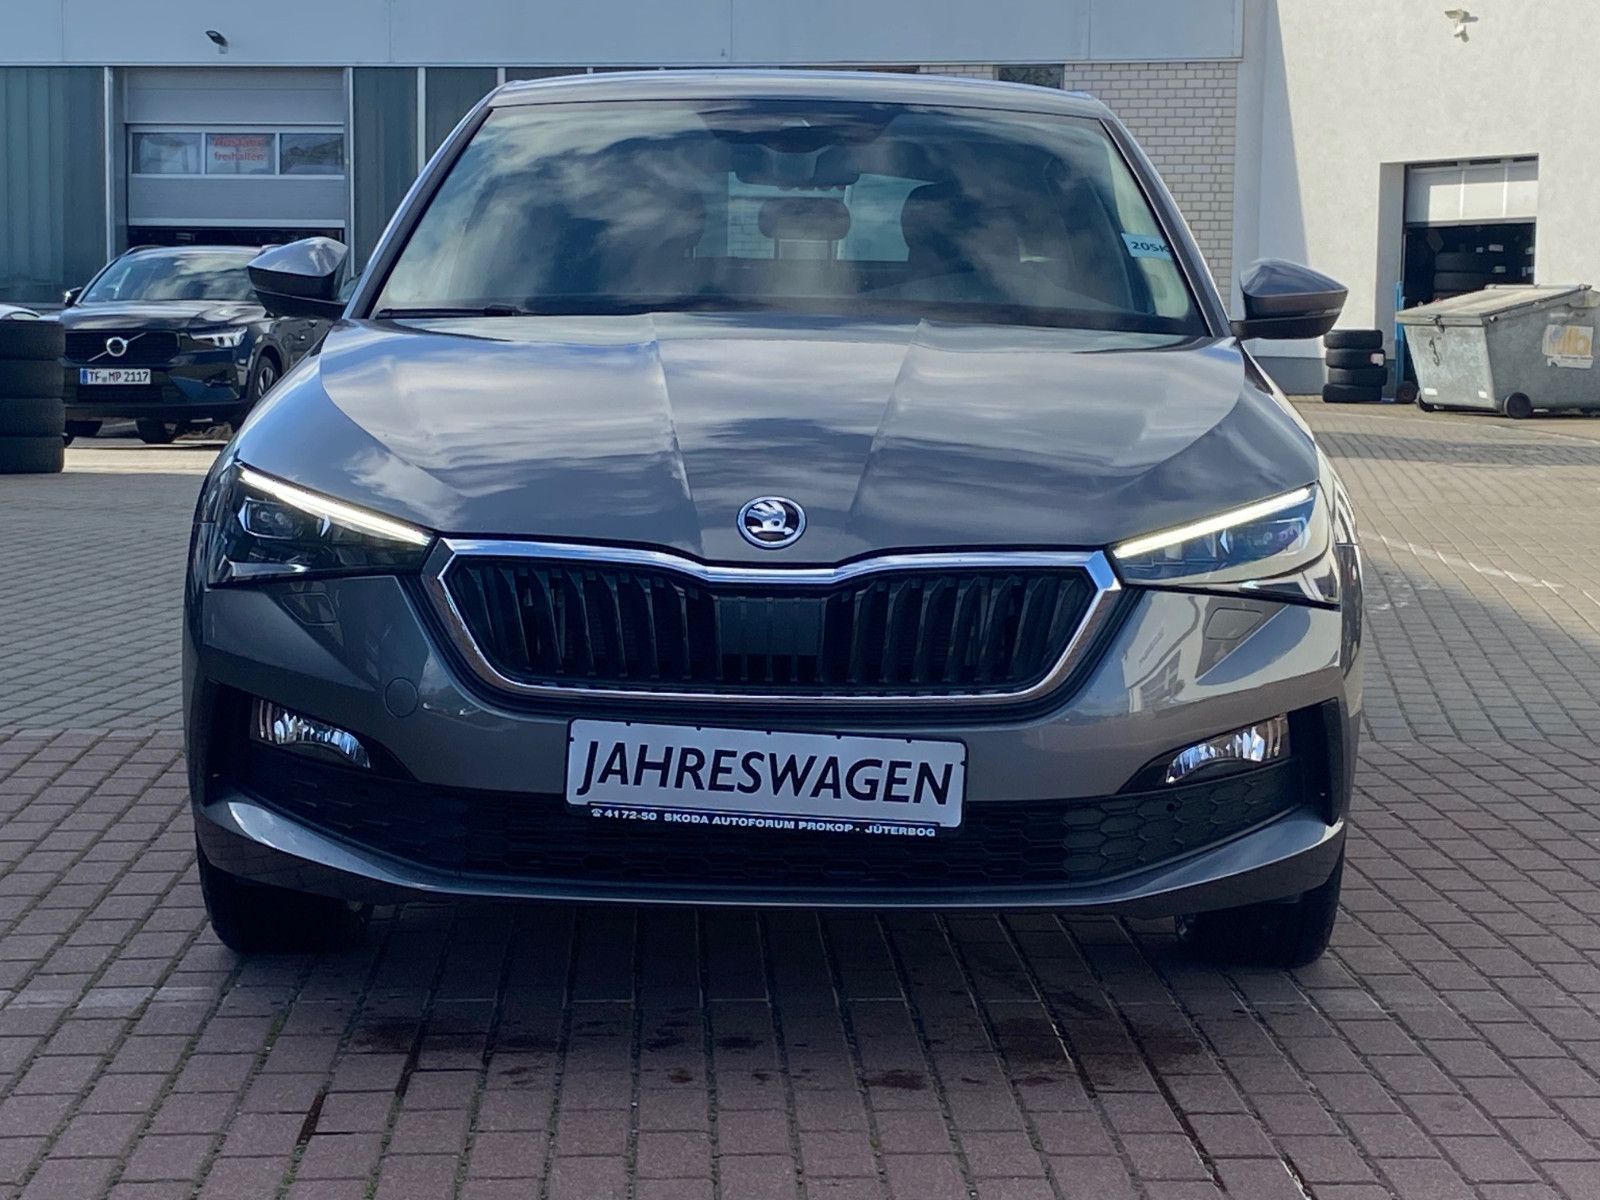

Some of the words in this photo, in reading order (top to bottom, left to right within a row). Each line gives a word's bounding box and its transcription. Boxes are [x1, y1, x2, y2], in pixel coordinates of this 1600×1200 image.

[88, 371, 102, 382] TF
[108, 371, 121, 382] MP
[123, 371, 149, 382] 2117
[576, 740, 953, 806] JAHRESWAGEN
[663, 812, 710, 825] SKODA
[711, 816, 796, 829] AUTOFORUM
[798, 820, 855, 832] PROKOP
[864, 823, 937, 837] JÜTERBOG
